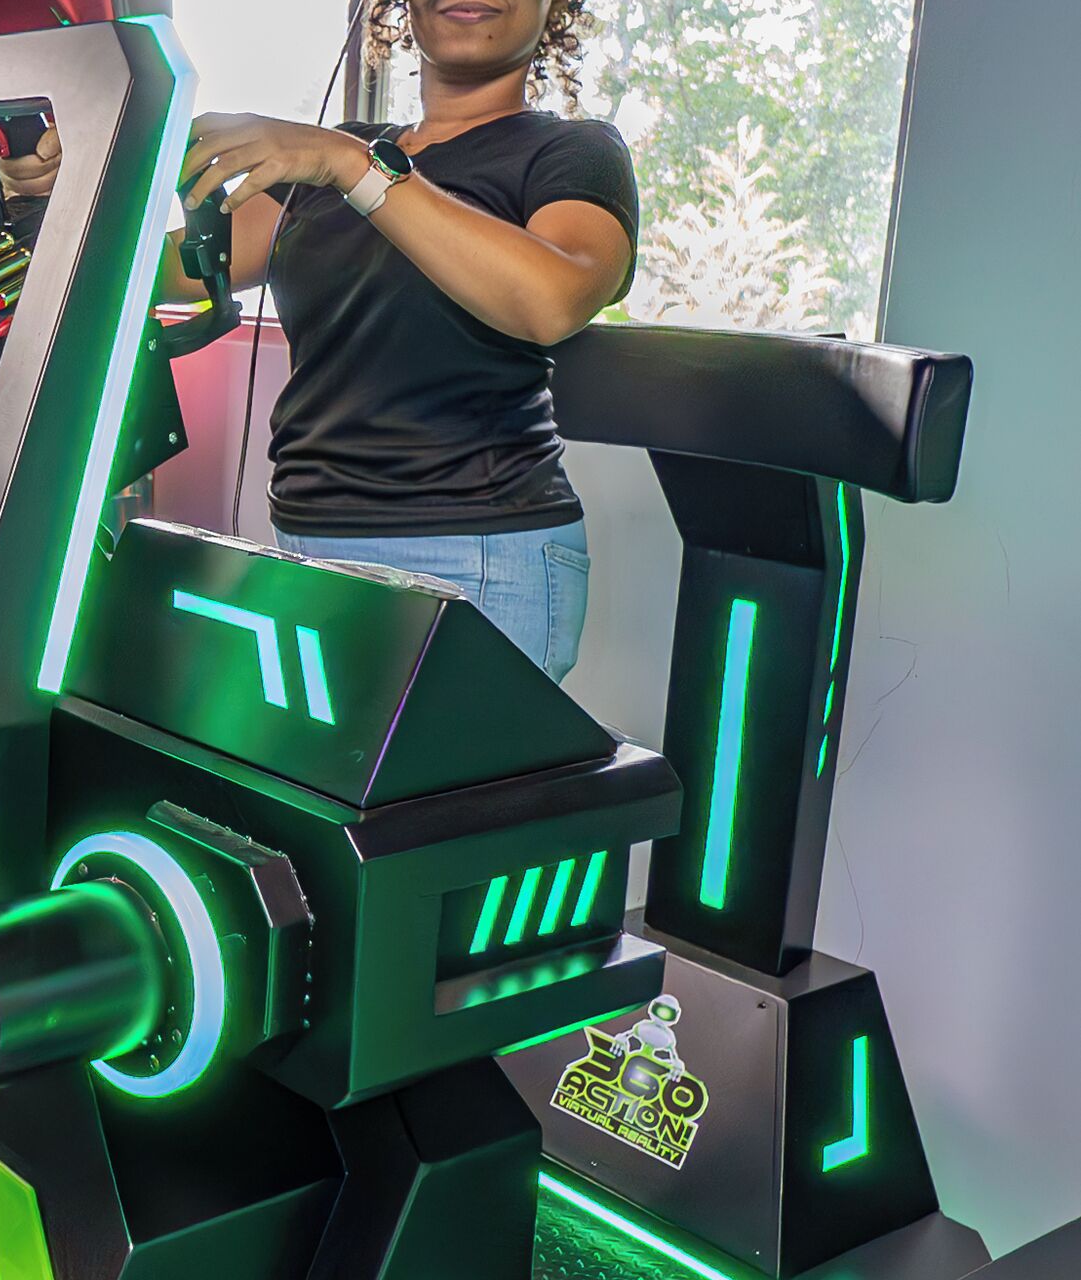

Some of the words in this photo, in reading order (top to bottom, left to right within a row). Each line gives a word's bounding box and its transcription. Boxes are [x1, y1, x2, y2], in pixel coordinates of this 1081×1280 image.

[560, 1070, 696, 1148] ACTION!
[570, 1028, 708, 1121] 360
[558, 1093, 615, 1131] VIRTUAL
[617, 1124, 680, 1162] REALITY
